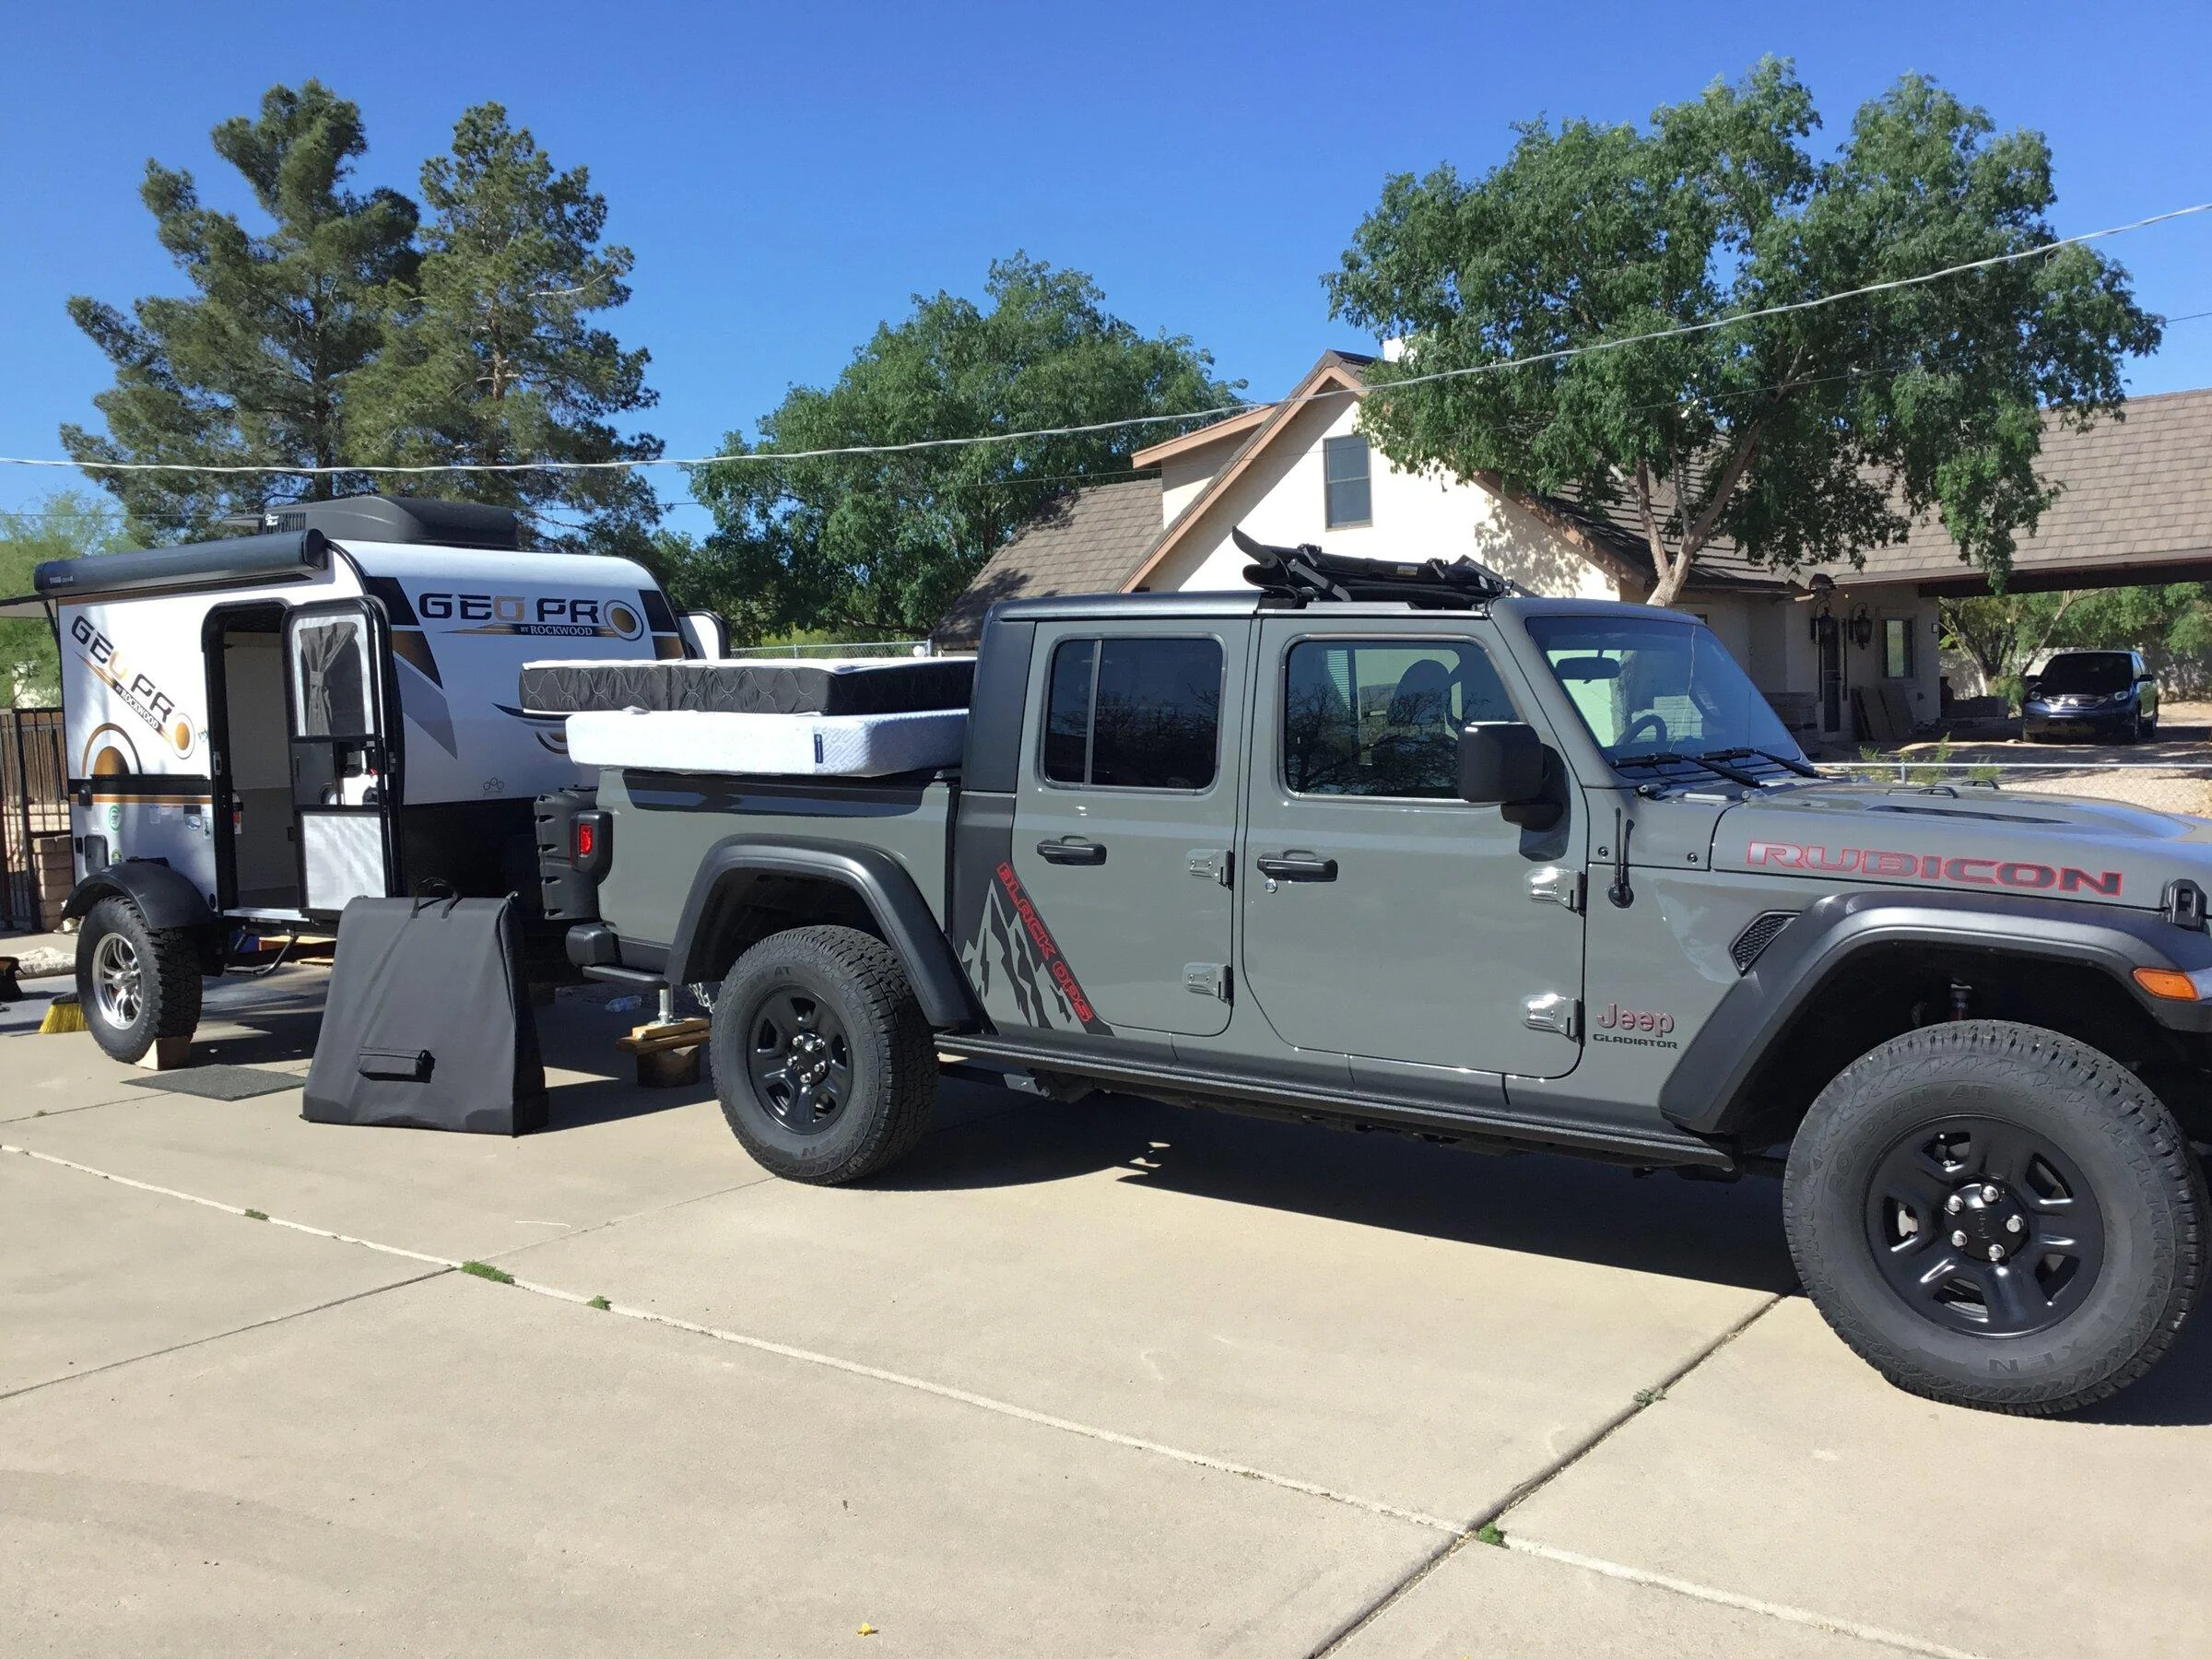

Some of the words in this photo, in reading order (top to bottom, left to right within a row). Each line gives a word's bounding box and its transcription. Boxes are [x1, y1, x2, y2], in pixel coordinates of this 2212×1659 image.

[418, 593, 526, 621] GEO
[530, 625, 593, 636] ROCKWOOD
[121, 689, 159, 729] ROCKWOOD
[1747, 841, 2123, 897] RUBICON
[996, 862, 1056, 960] BLACK
[1052, 960, 1093, 1022] OPS
[1596, 1003, 1675, 1038] Jeep
[1593, 1033, 1678, 1049] GLADIATOR
[1947, 1083, 1992, 1101] AT
